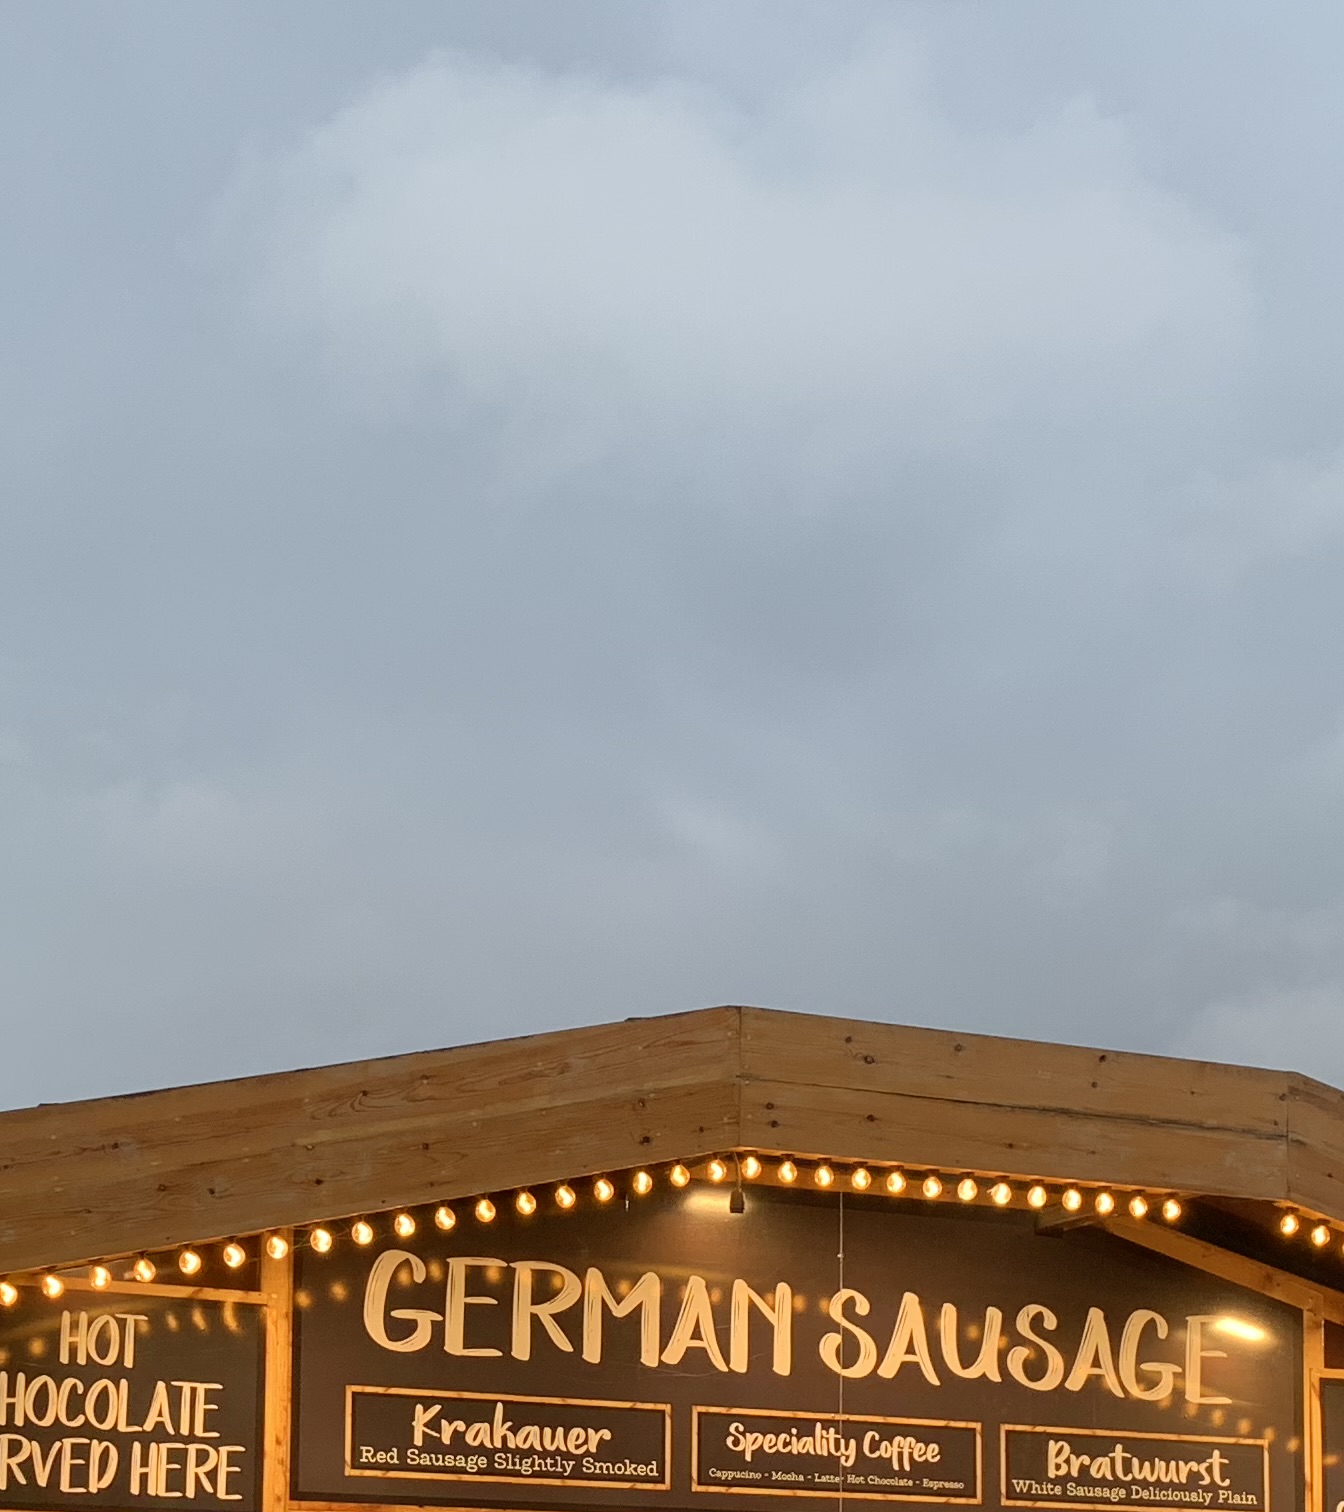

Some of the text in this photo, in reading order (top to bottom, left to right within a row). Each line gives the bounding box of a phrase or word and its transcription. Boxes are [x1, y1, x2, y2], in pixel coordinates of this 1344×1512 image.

[59, 1310, 149, 1369] HOT
[362, 1248, 1233, 1405] GERMAN SAUSAGE
[412, 1402, 611, 1454] Krakauer
[726, 1421, 940, 1471] Speciality Coffee
[130, 1441, 247, 1500] HERE
[359, 1446, 659, 1477] Red Sausage Slightly Smoked
[709, 1468, 762, 1480] Cappucino
[771, 1471, 804, 1482] Mocha
[814, 1473, 840, 1483] Latte
[847, 1474, 864, 1484] Hot
[868, 1475, 913, 1487] Chocolate
[922, 1479, 965, 1490] Espresso
[1047, 1439, 1230, 1487] Bratwurst
[1012, 1479, 1258, 1505] White Sausage Deliciously Plain
